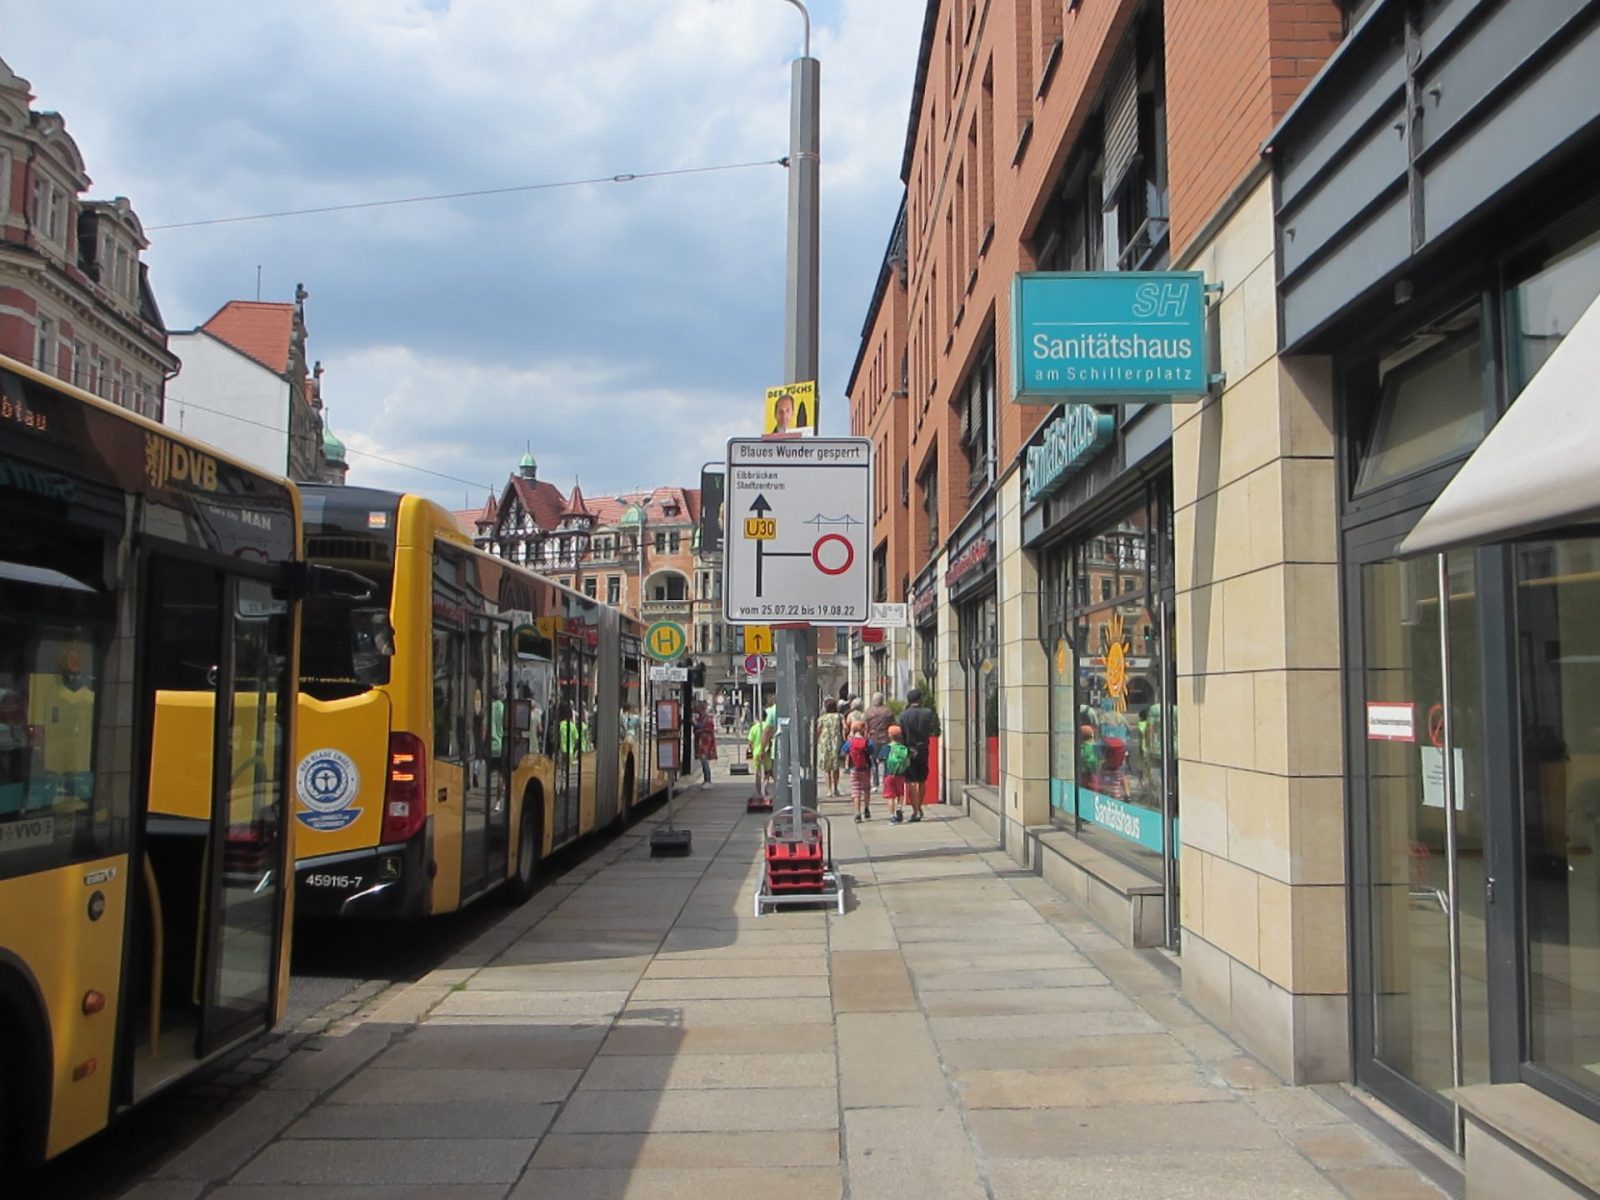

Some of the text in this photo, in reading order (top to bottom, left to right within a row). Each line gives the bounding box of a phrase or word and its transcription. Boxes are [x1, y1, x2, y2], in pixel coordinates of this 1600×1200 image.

[1132, 282, 1190, 317] SH
[1032, 334, 1192, 360] Sanitätshaus
[1035, 367, 1192, 383] am Schillerplatz
[740, 445, 860, 461] Blaues Wunder gesperrt
[171, 445, 219, 492] DVB
[736, 471, 778, 480] Elbbrücken
[736, 481, 785, 490] Stadtzentrum
[241, 510, 272, 531] MAN
[746, 520, 775, 536] U30
[740, 605, 855, 616] vom 25.07.22 bis 19.08.22
[657, 630, 674, 652] H
[1095, 796, 1140, 838] Sanitätshaus
[305, 874, 363, 888] 459115-7
